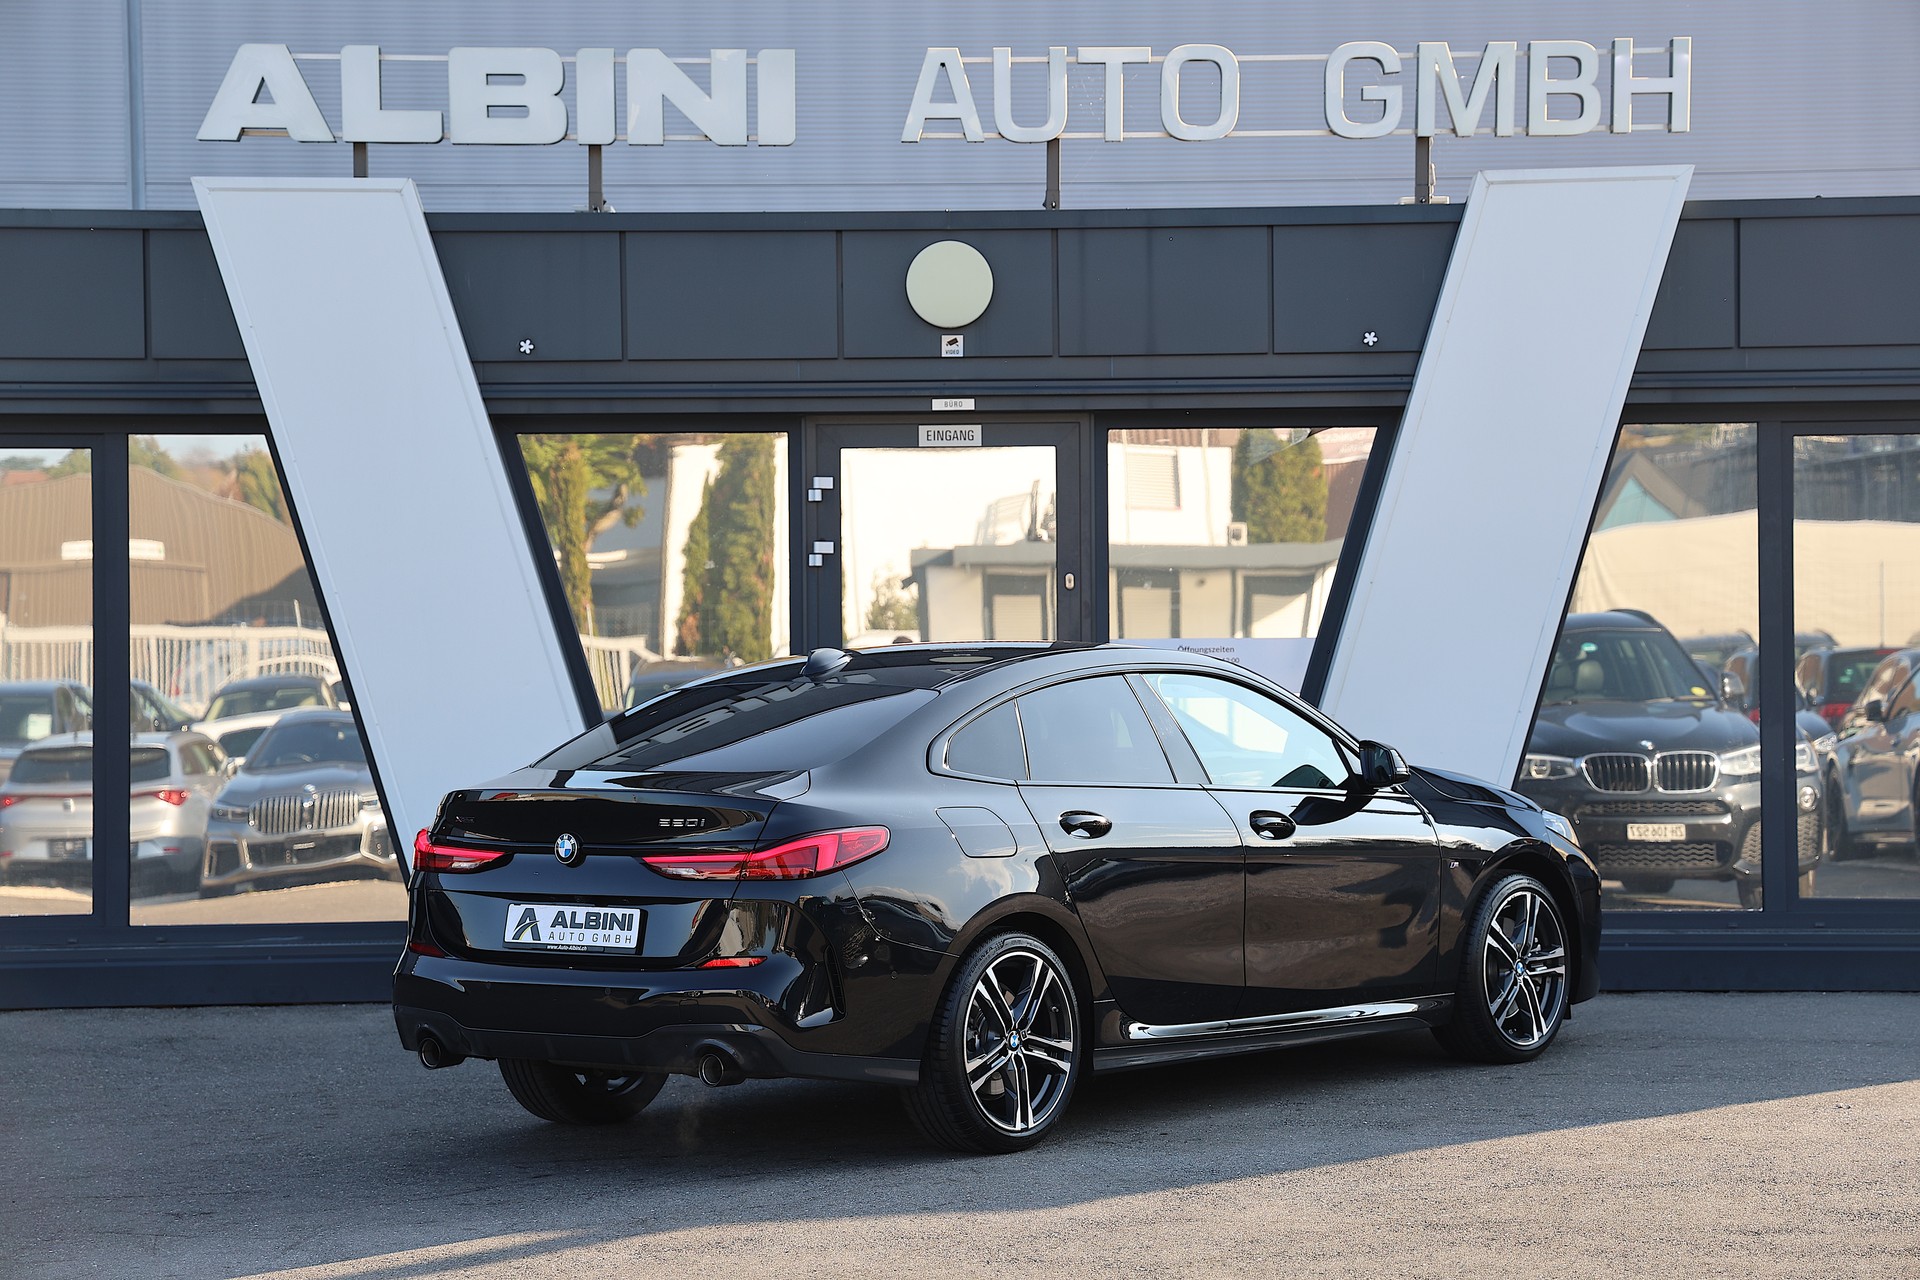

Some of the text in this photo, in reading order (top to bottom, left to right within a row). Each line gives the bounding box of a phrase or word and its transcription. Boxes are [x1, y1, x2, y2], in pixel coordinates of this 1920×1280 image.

[195, 36, 1693, 147] ALBINI AUTO GMBH
[926, 429, 975, 442] EINGANG
[549, 910, 635, 932] ALBINI
[548, 931, 632, 944] AUTO GMBH
